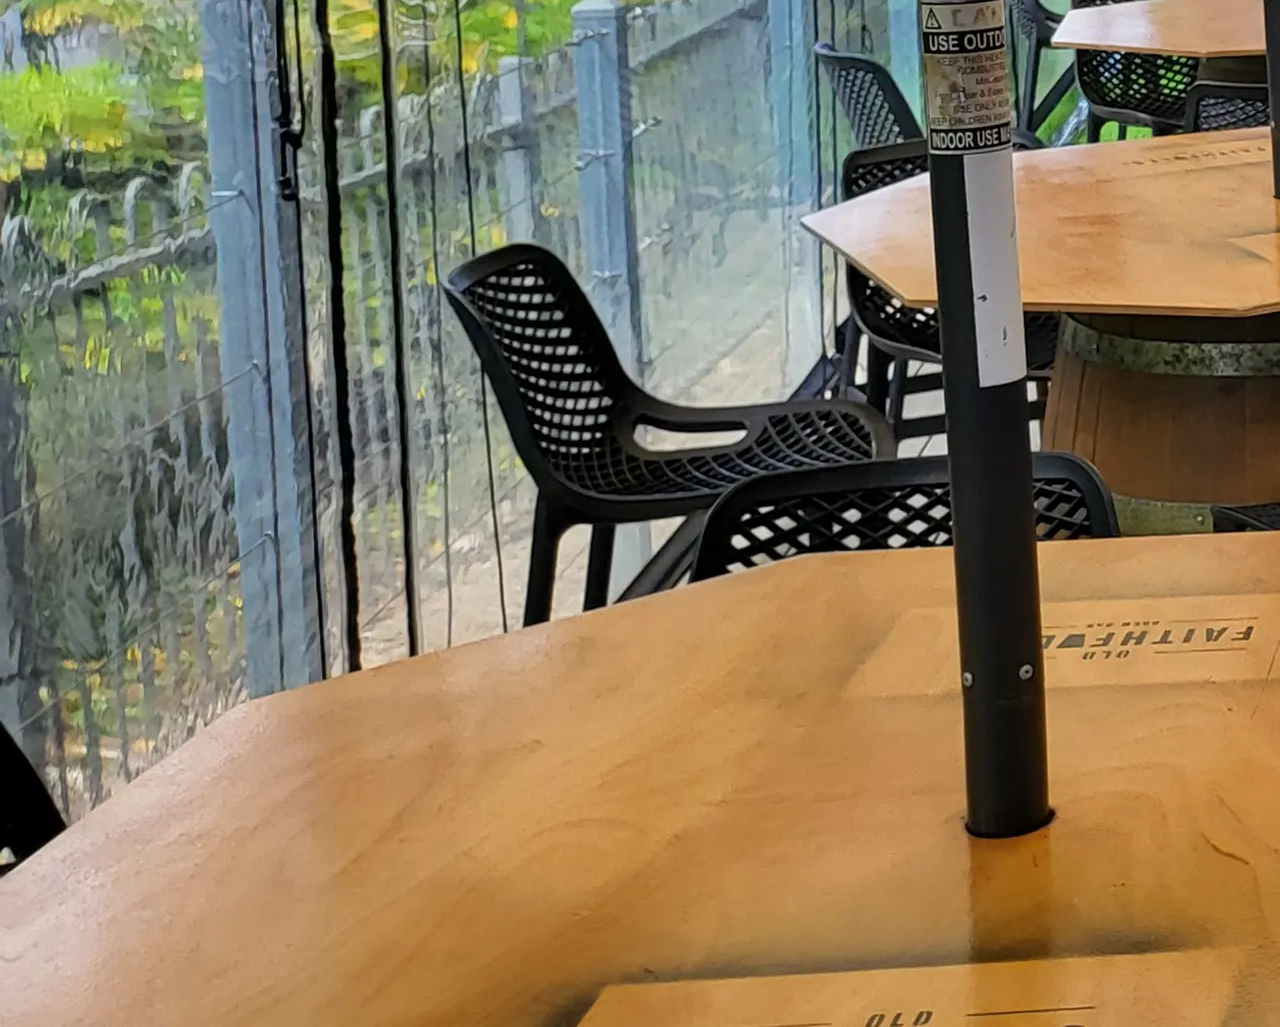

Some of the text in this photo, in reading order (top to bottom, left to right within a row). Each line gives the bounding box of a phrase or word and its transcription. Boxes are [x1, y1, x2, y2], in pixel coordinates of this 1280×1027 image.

[929, 34, 960, 52] USE
[931, 131, 975, 149] INDOOR
[976, 128, 1000, 145] USE
[1082, 649, 1130, 660] OLD
[865, 1010, 933, 1027] OLD
